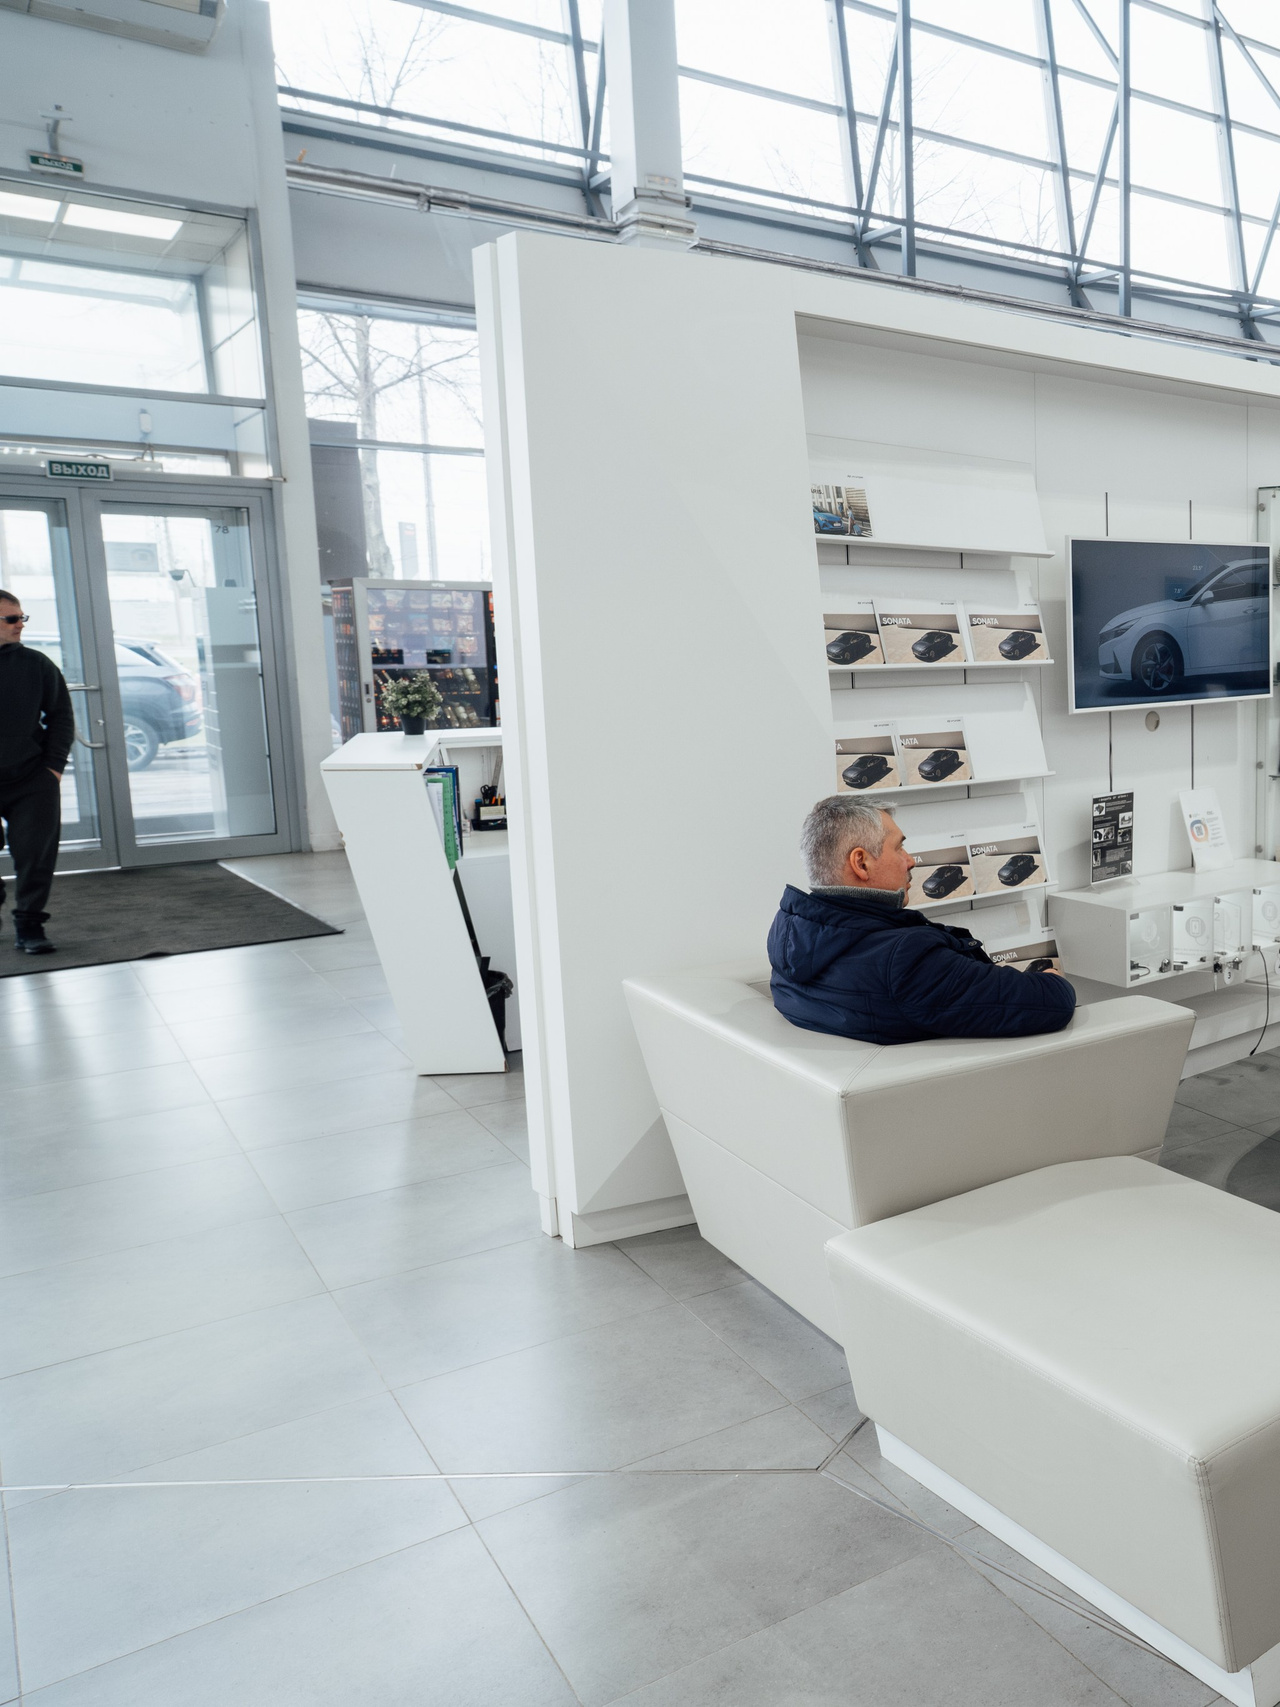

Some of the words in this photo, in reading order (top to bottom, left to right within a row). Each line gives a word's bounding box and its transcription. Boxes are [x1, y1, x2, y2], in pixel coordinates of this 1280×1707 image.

[51, 463, 110, 478] ВЫХОД
[882, 617, 912, 625] SONATA
[972, 617, 999, 625] SONATA
[971, 845, 998, 855] SONATA
[992, 951, 1018, 962] SONATA
